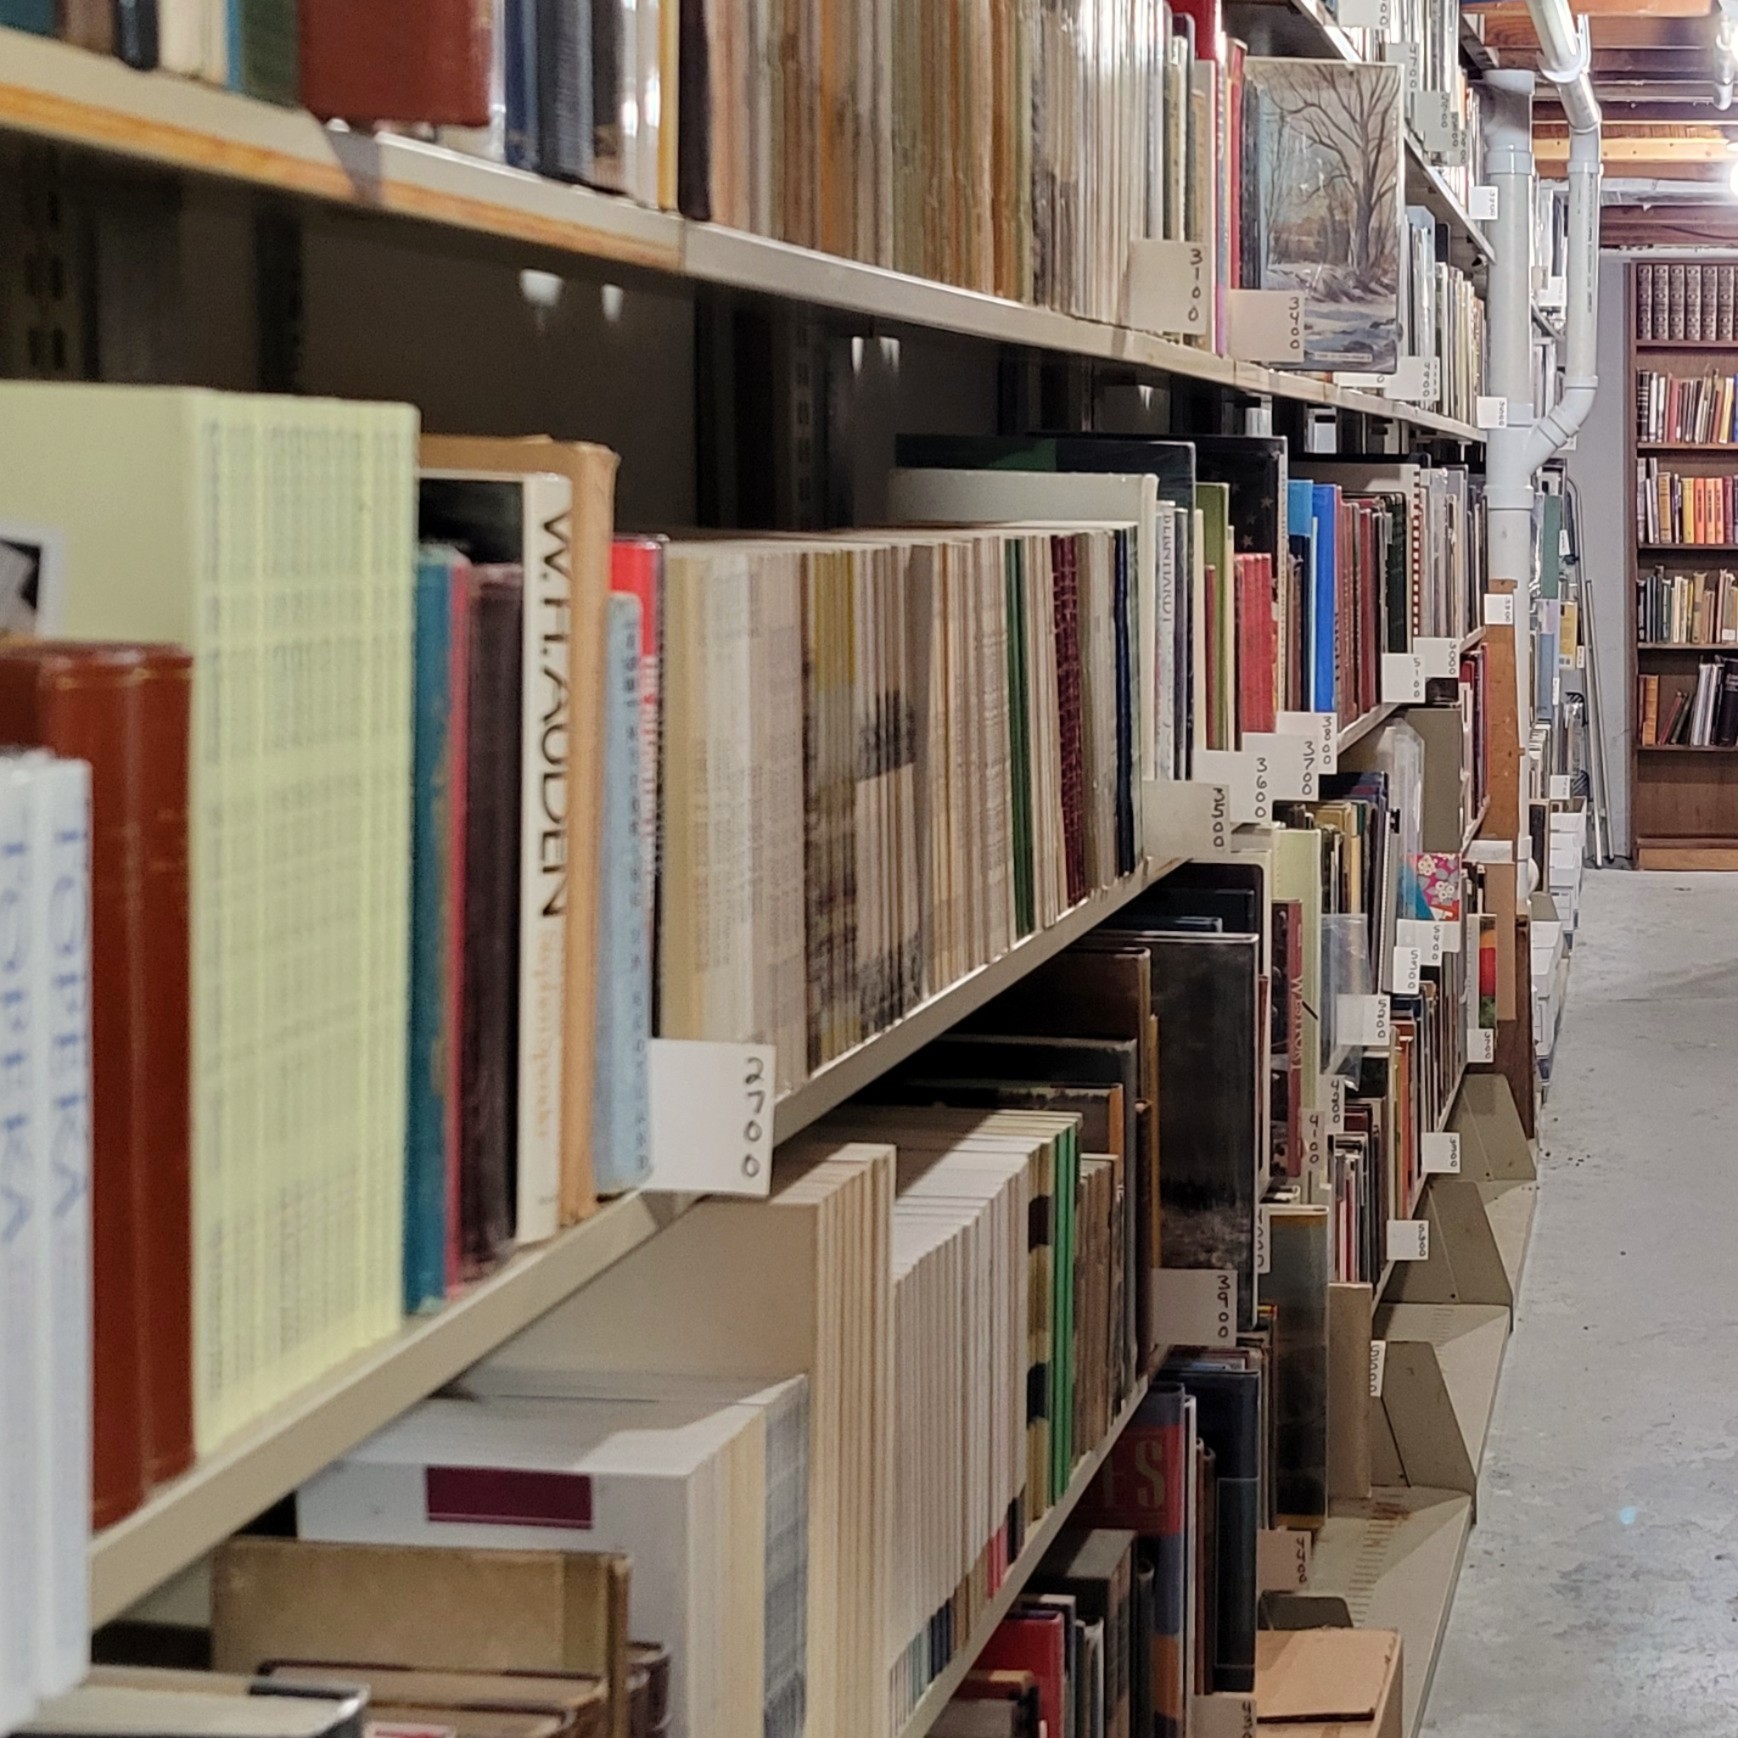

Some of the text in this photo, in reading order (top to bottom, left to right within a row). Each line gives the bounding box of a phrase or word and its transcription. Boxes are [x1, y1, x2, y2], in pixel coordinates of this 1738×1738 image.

[1188, 249, 1203, 322] 3100
[1288, 297, 1301, 350] 3400
[1413, 657, 1421, 698] 5100
[1302, 741, 1315, 795] 3700
[1322, 716, 1332, 765] 3800
[537, 666, 571, 919] AUDEN
[1211, 787, 1225, 847] 3500
[1255, 757, 1268, 818] 3600
[742, 1057, 765, 1178] 2700
[1217, 1275, 1231, 1338] 3900
